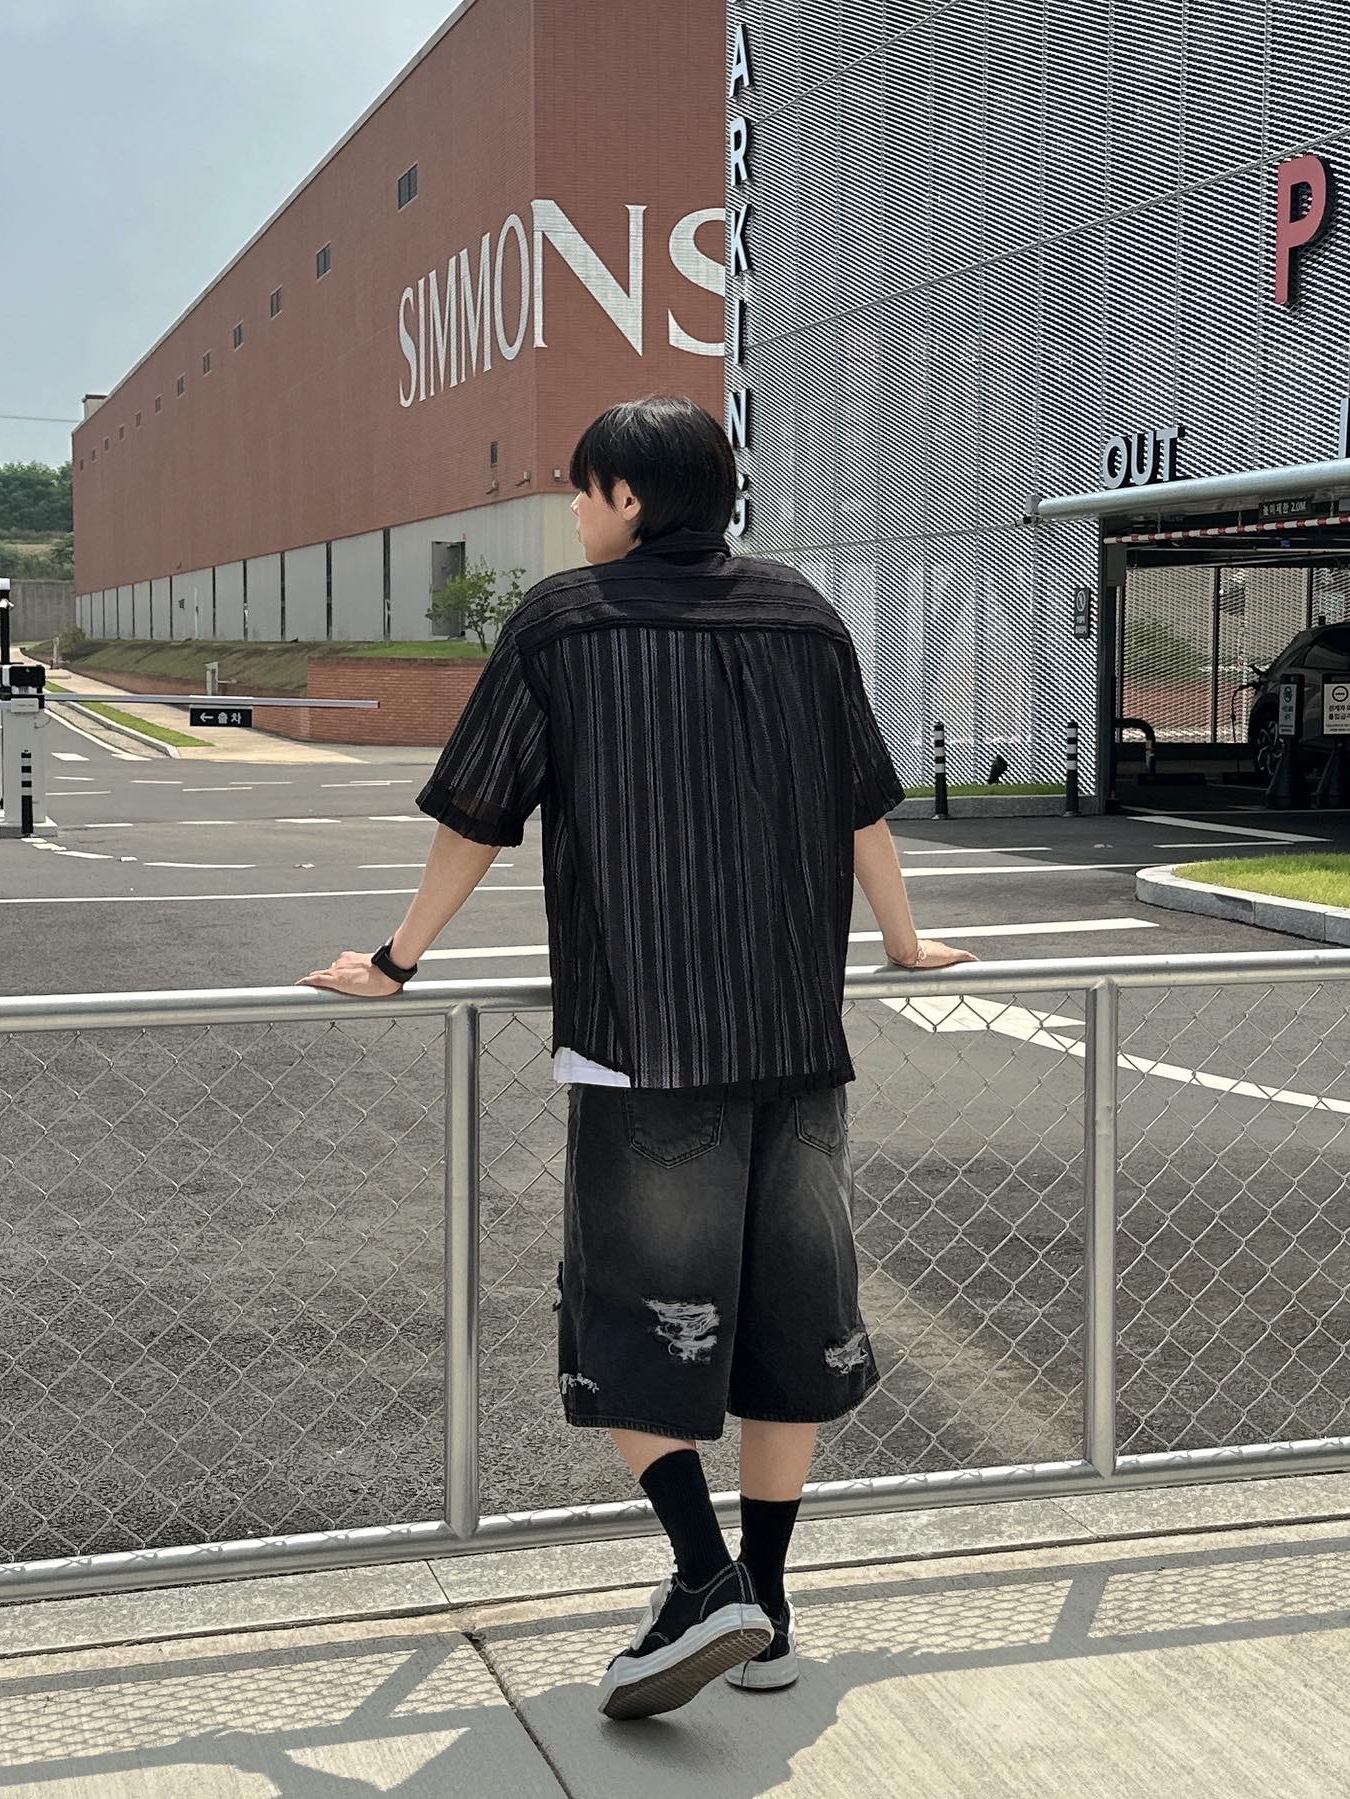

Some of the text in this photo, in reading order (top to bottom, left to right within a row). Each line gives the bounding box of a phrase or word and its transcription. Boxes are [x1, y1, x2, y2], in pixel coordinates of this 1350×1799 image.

[1275, 154, 1327, 305] P
[398, 198, 726, 408] SIMMONS
[1102, 427, 1179, 489] OUT
[217, 711, 242, 725] 출차
